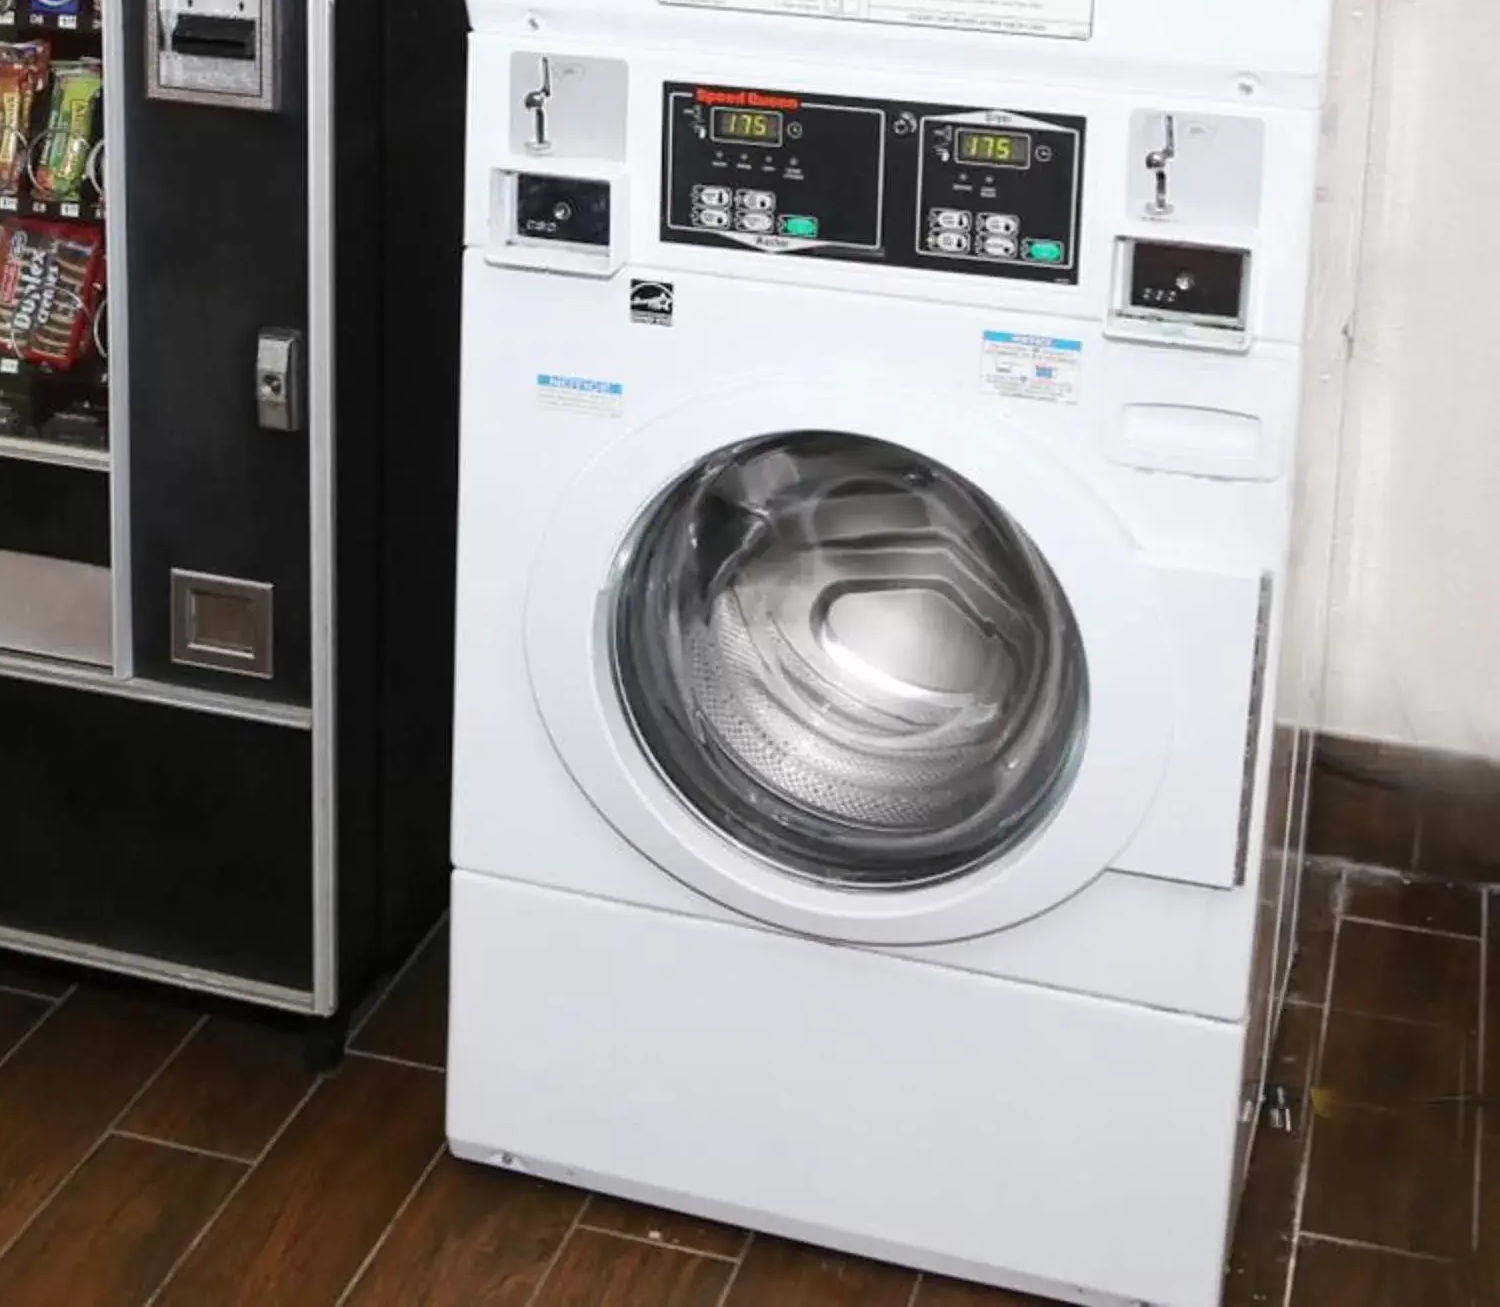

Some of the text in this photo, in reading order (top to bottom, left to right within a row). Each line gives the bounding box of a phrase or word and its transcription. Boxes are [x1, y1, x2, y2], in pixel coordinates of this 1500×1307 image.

[695, 88, 799, 109] Speed Queen
[728, 113, 768, 136] 175
[968, 135, 1011, 159] 175
